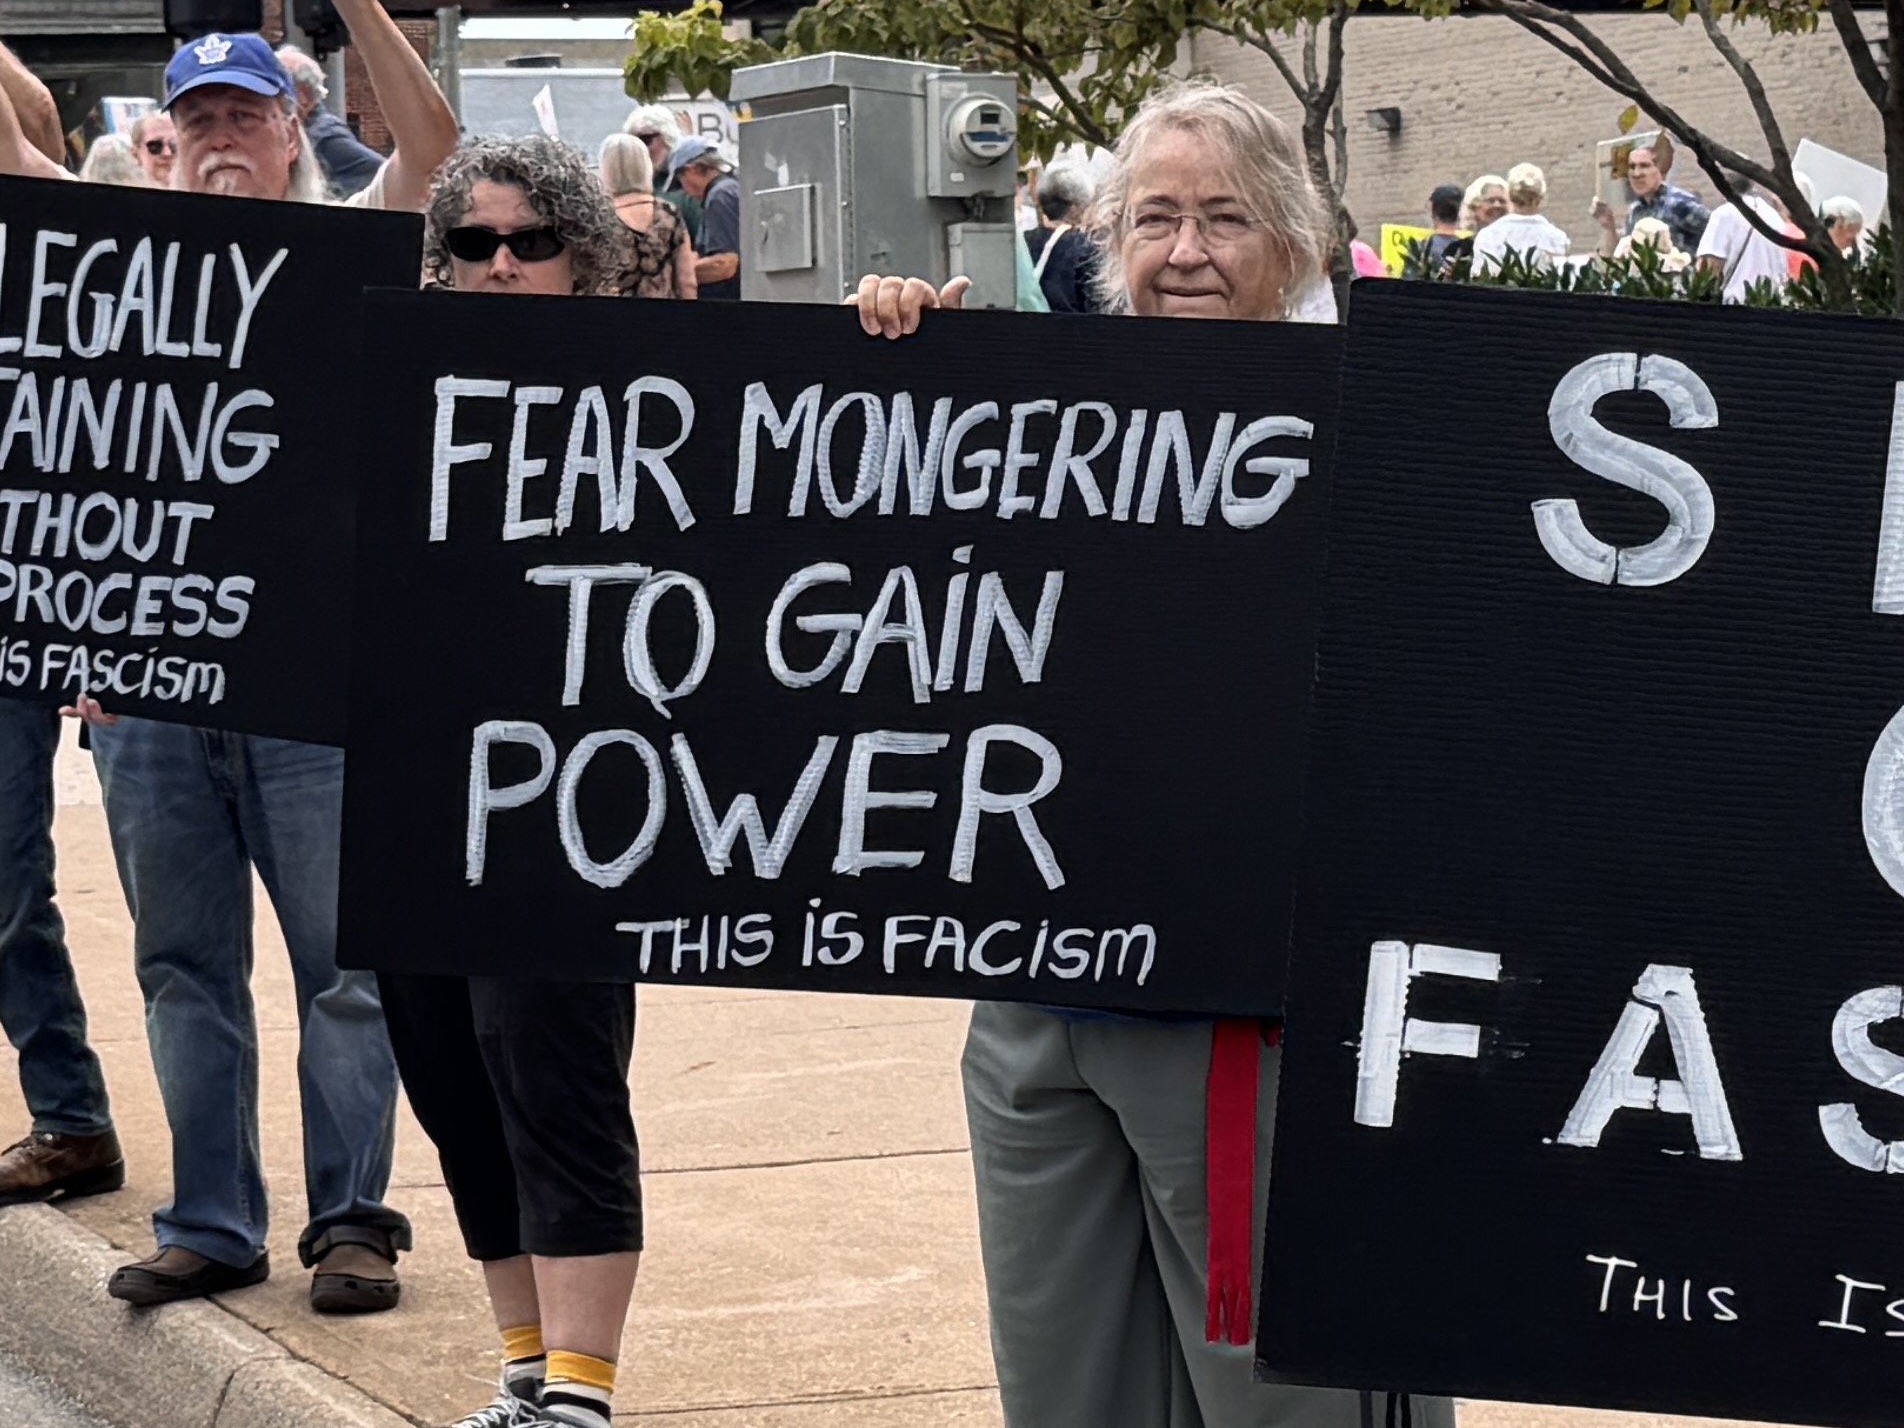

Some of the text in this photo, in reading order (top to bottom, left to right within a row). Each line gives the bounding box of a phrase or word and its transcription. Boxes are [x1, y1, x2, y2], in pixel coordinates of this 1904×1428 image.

[428, 373, 1315, 542] FEAR MONGERING
[524, 561, 717, 719] TO
[465, 719, 1065, 891] POWER
[615, 912, 776, 974] THIS
